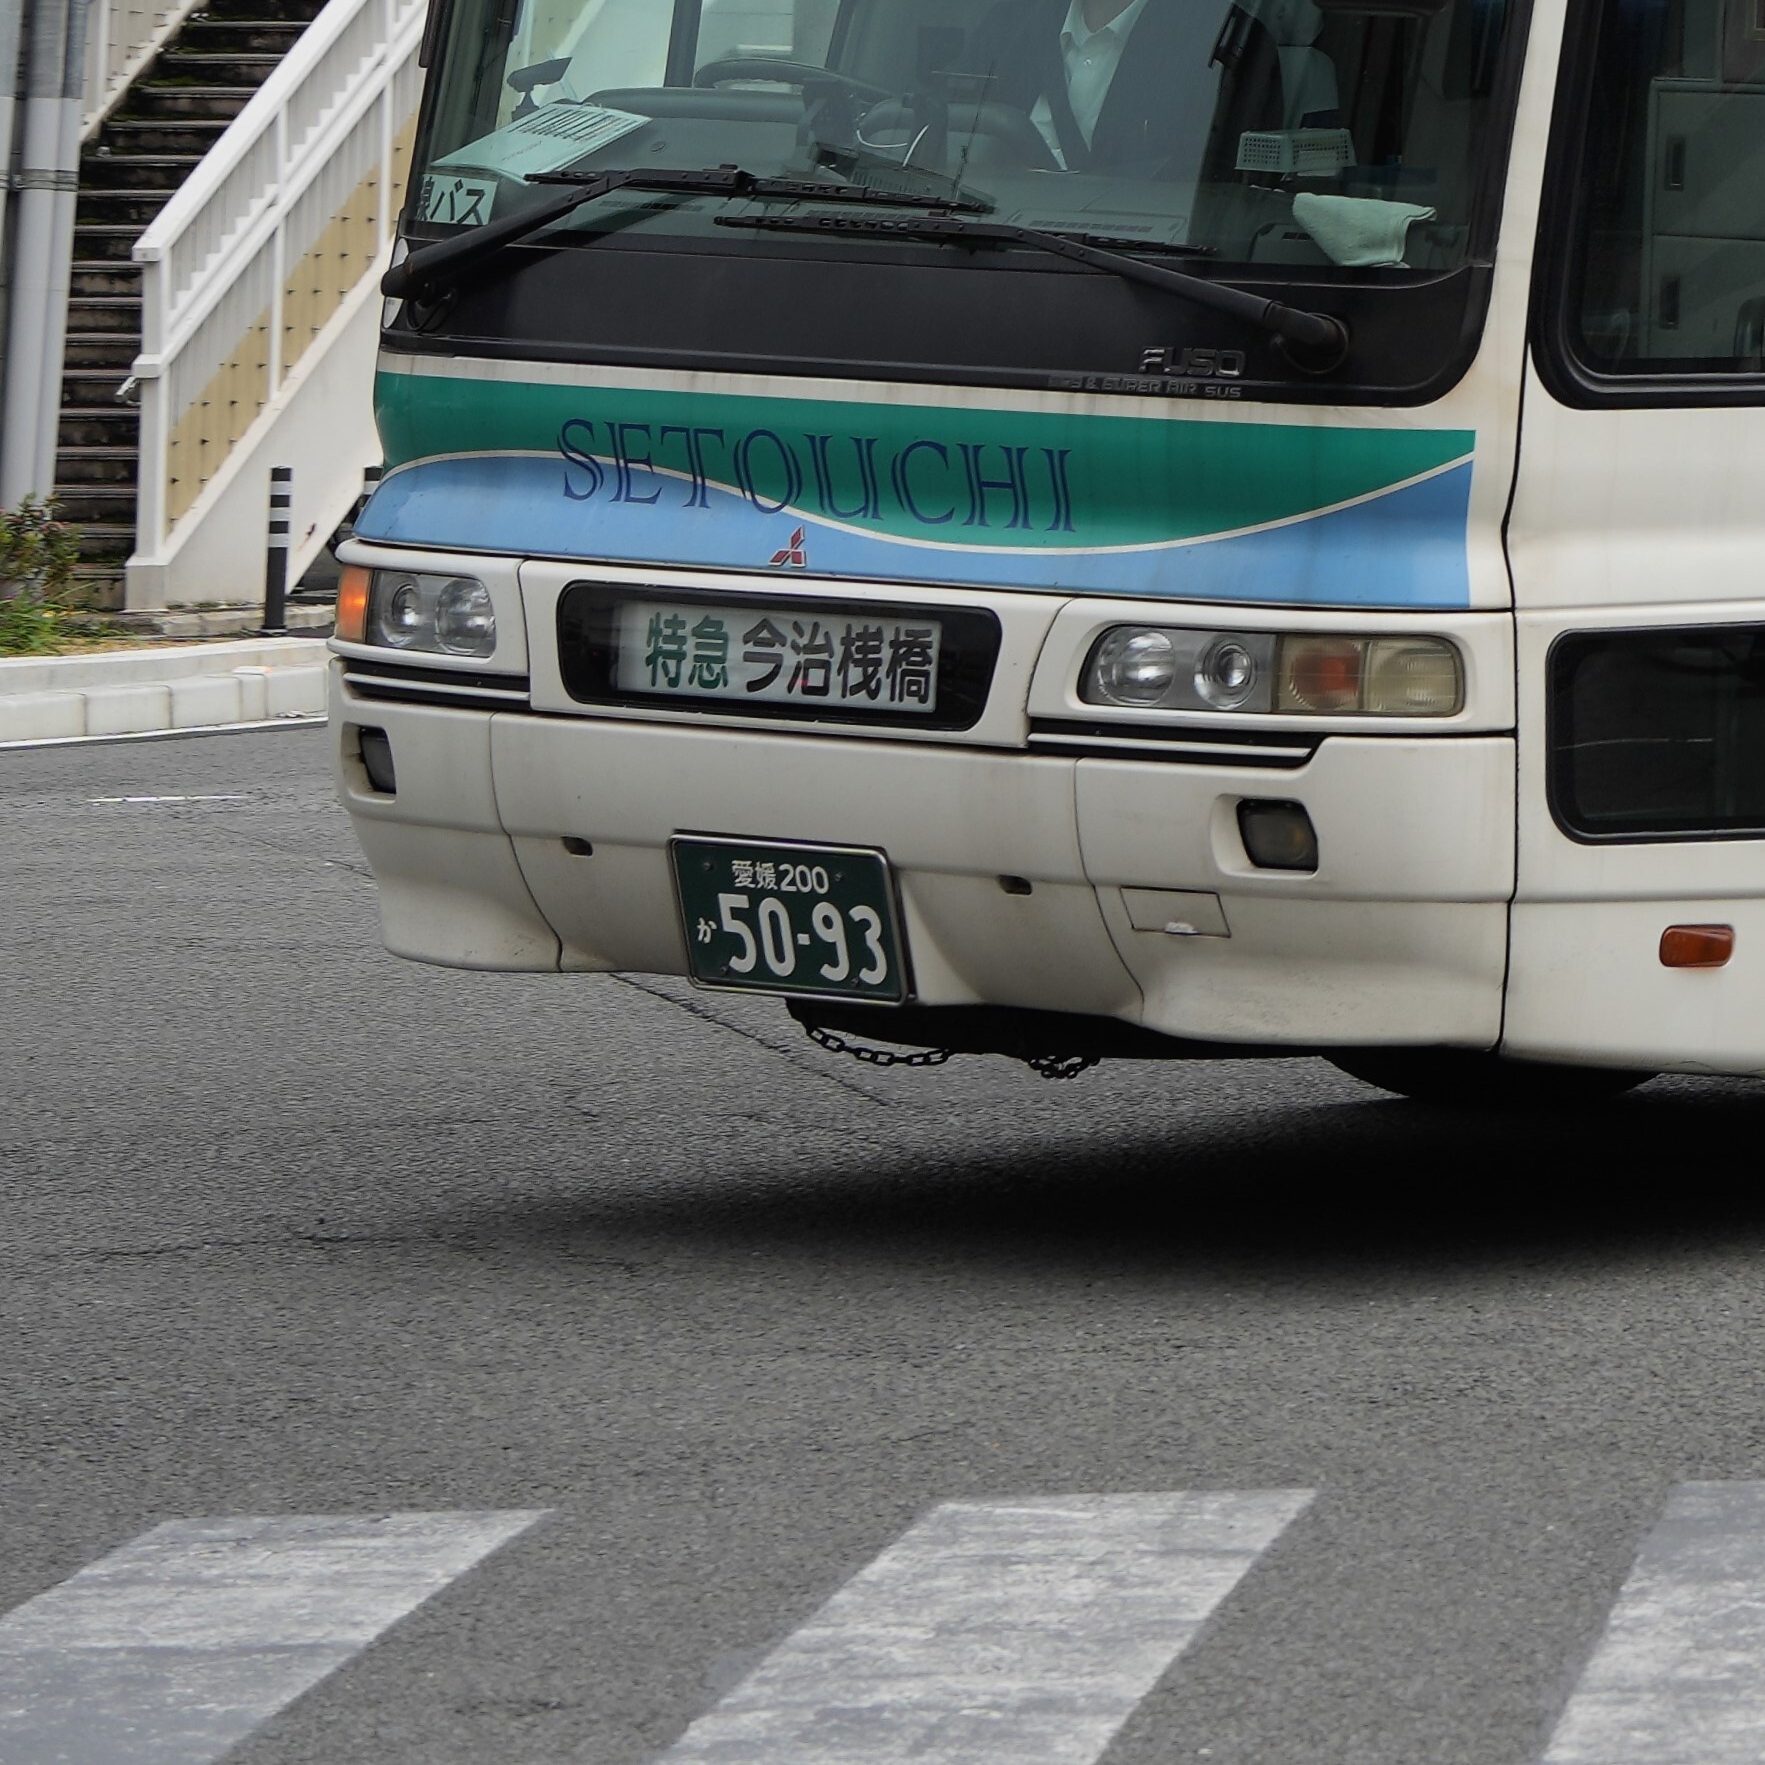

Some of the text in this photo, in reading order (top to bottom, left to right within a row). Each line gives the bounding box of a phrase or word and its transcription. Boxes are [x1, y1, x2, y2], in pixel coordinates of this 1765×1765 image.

[1138, 346, 1246, 378] FUSO
[1204, 385, 1242, 399] SUS
[557, 417, 1077, 533] SETOUCHI
[644, 610, 934, 705] 特急 今治桟橋
[696, 892, 888, 986] か 50-93
